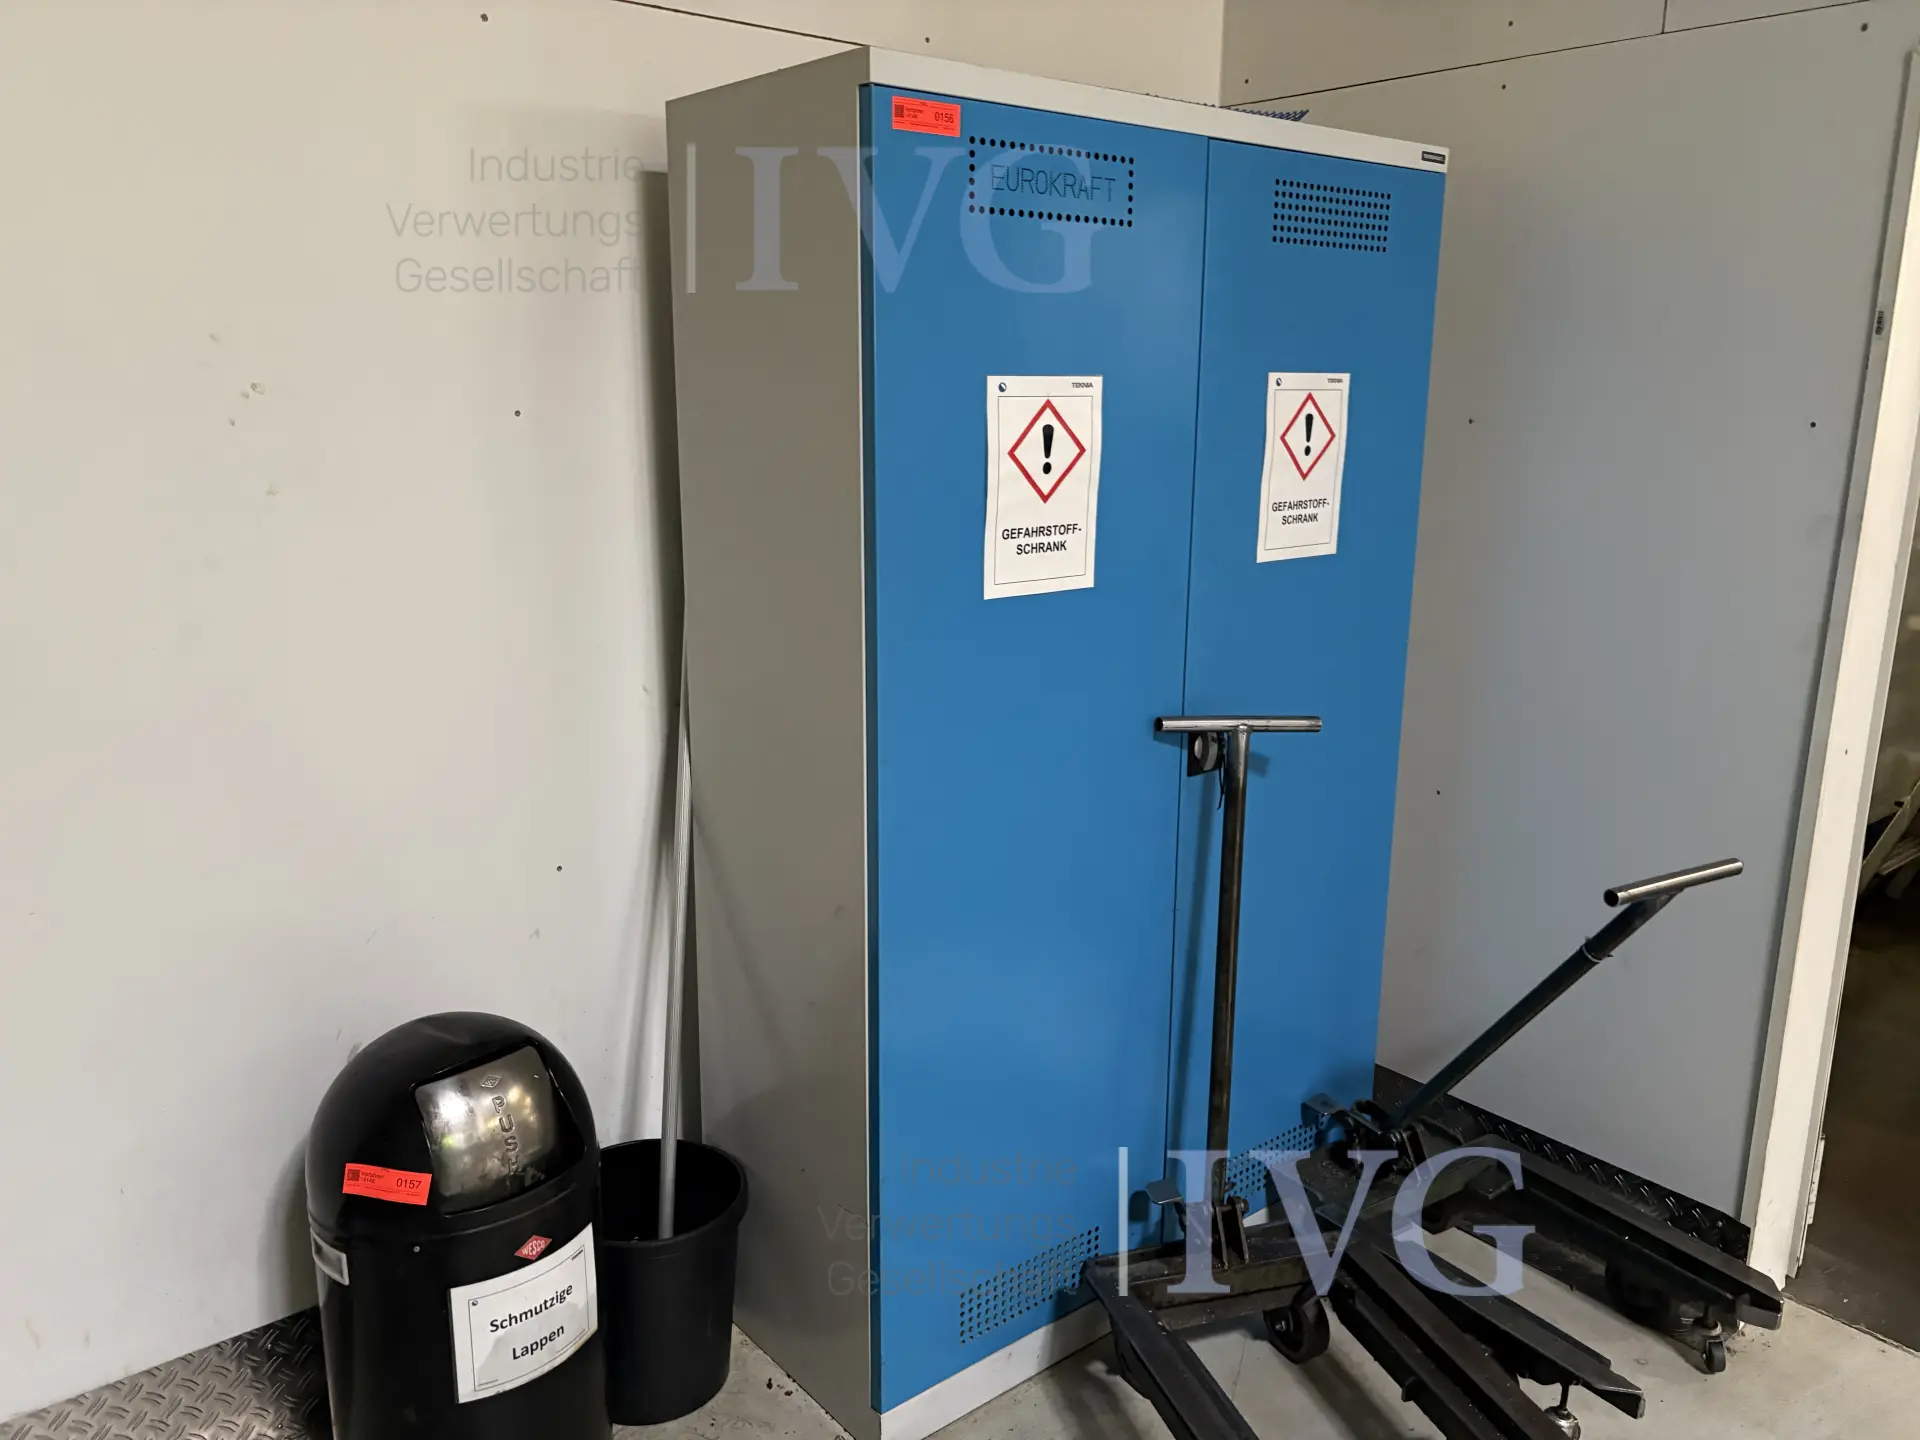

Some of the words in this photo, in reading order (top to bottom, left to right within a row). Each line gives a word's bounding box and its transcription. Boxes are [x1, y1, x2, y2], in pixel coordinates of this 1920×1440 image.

[934, 111, 955, 124] 0156
[990, 162, 1117, 204] EUROKRAFT
[1271, 498, 1330, 512] GEFAHRSTOFF-
[1281, 512, 1319, 526] SCHRANK
[1001, 523, 1082, 540] GEFAHRSTOFF-
[1016, 540, 1067, 555] SCHRANK
[491, 1094, 522, 1176] PUSH
[396, 1177, 422, 1190] 0157
[522, 1239, 546, 1256] WESCO
[489, 1284, 573, 1333] Schmutzige
[512, 1325, 565, 1360] Lappen
